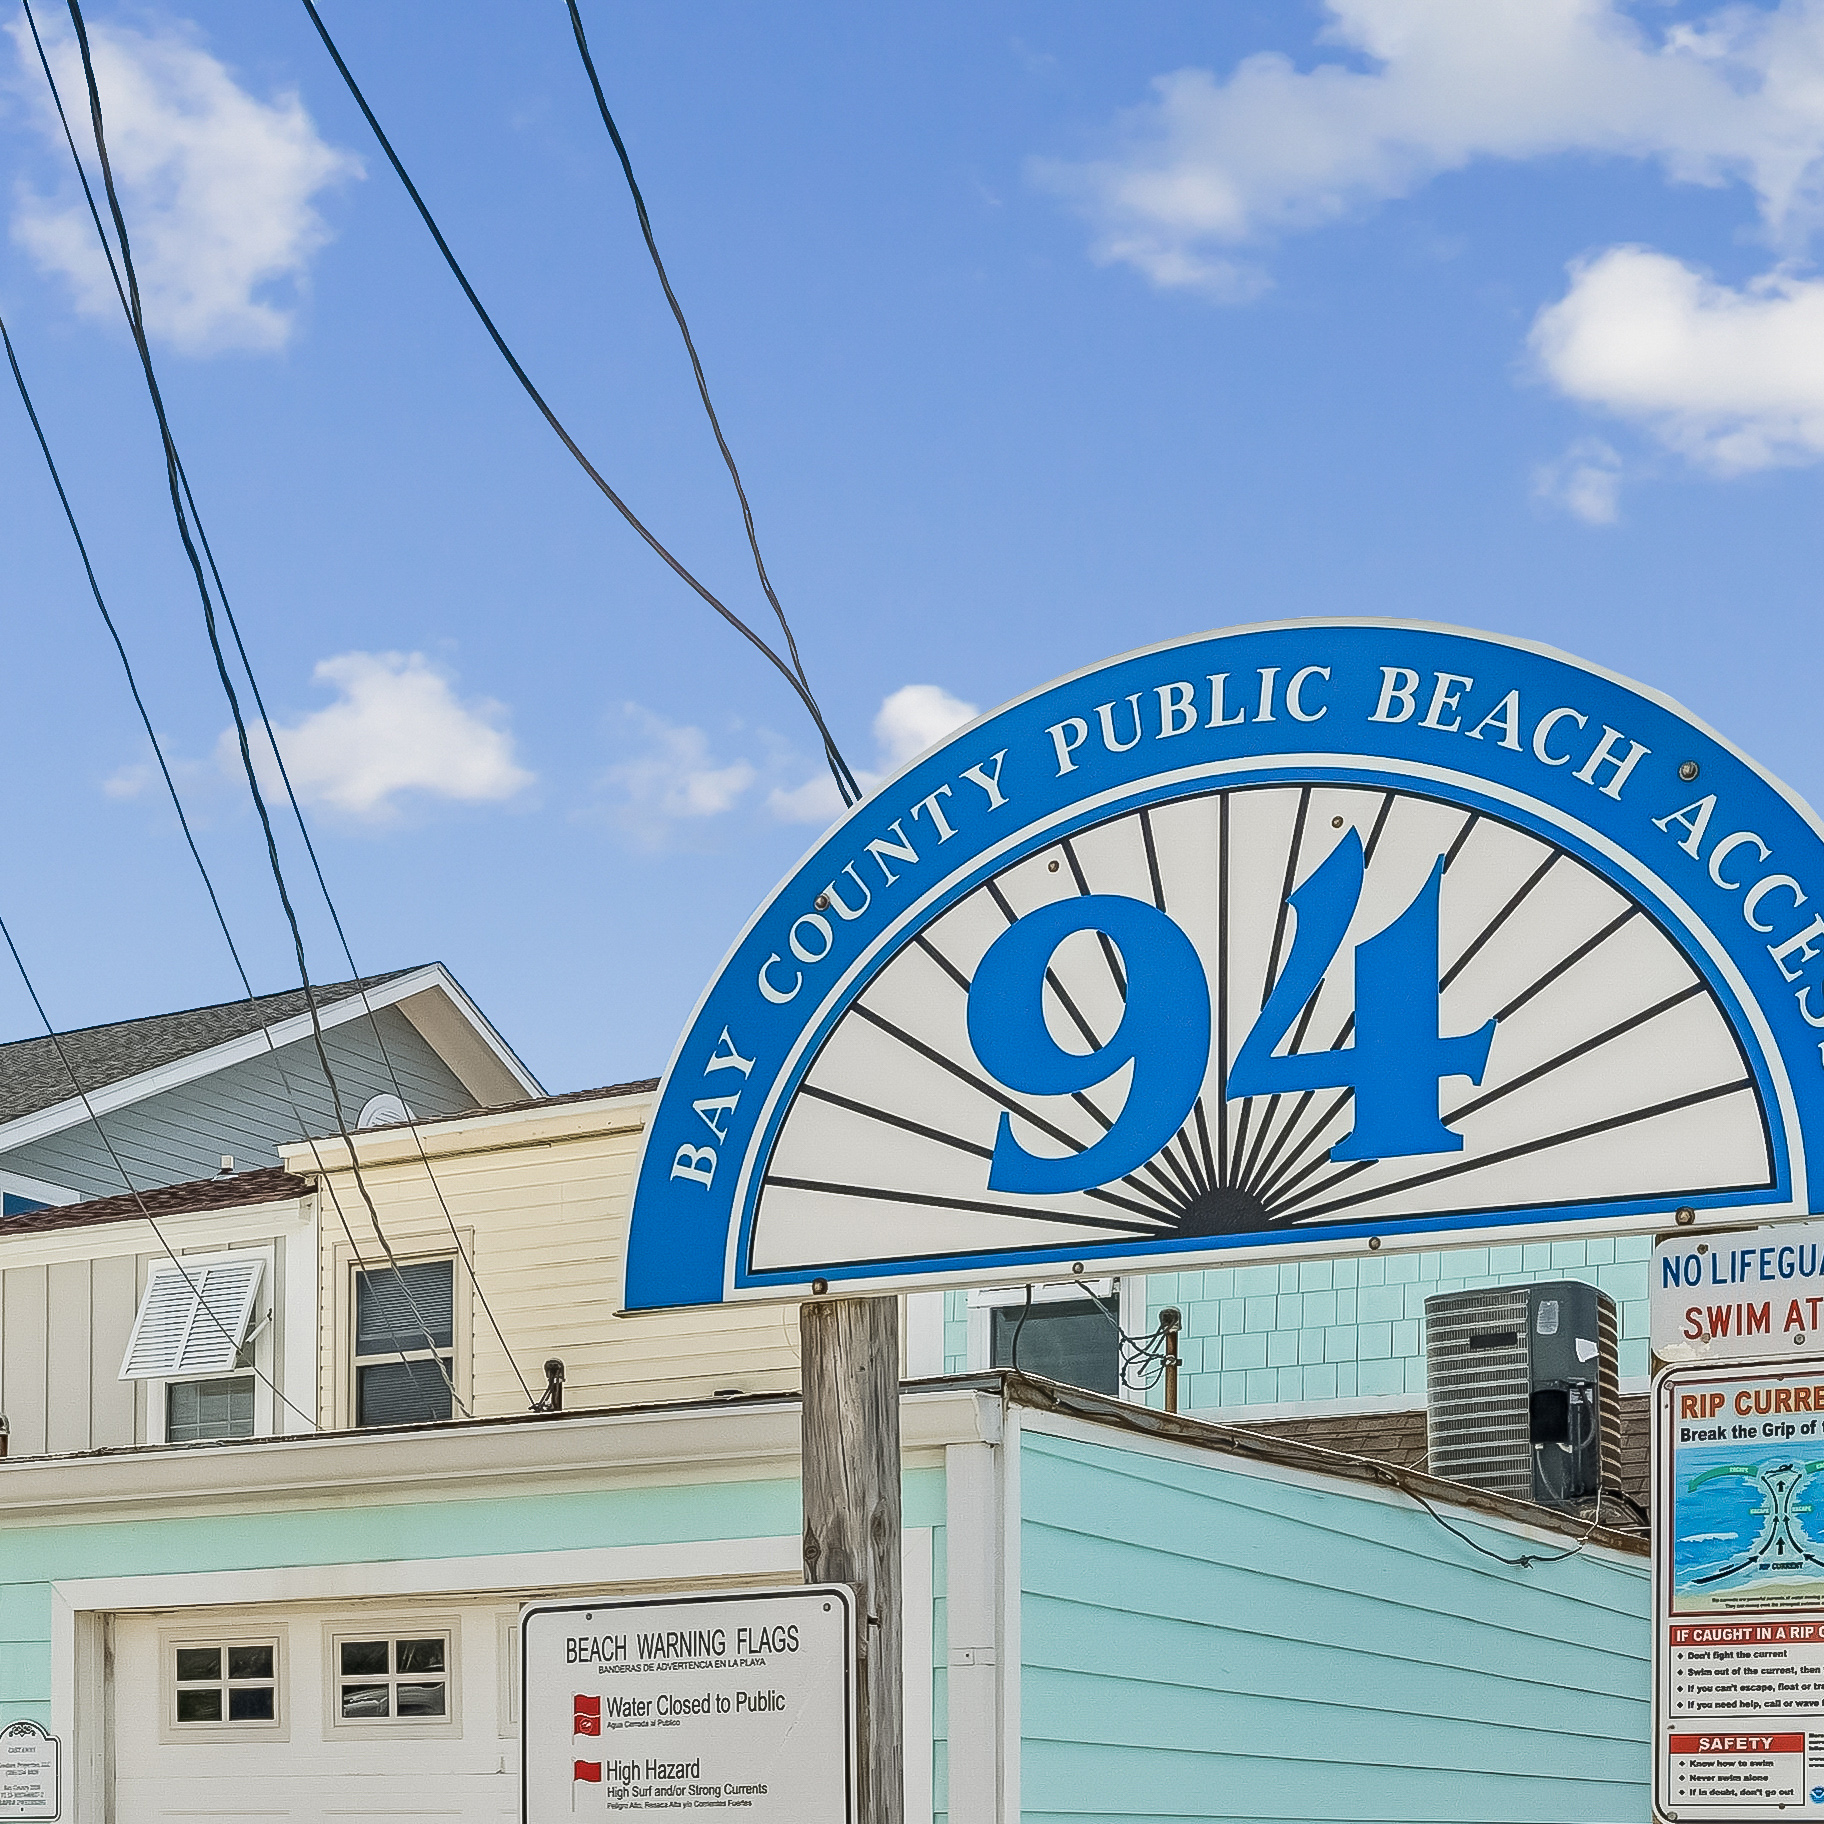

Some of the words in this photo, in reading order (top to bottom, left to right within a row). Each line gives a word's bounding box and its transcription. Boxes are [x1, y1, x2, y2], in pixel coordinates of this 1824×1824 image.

[670, 1027, 766, 1191] BAY
[757, 750, 1012, 1002] COUNTY
[1048, 662, 1331, 777] PUBLIC
[1368, 663, 1651, 802] BEACH
[968, 824, 1498, 1194] 94
[1663, 1253, 1703, 1288] NO
[1683, 1302, 1771, 1339] SWIM
[1784, 1298, 1824, 1332] AT
[1681, 1391, 1725, 1419] RIP
[1681, 1426, 1727, 1442] Break
[1732, 1425, 1757, 1438] the
[1763, 1422, 1795, 1439] Grip
[1801, 1420, 1817, 1434] of
[567, 1635, 626, 1663] BEACH
[637, 1629, 725, 1659] WARNING
[738, 1625, 799, 1654] FLAGS
[1676, 1630, 1689, 1642] IF
[1693, 1628, 1752, 1641] CAUGHT
[1756, 1628, 1771, 1639] IN
[1776, 1628, 1785, 1639] A
[1790, 1626, 1814, 1638] RIP
[599, 1664, 641, 1674] BANDERAS
[643, 1663, 654, 1672] DE
[656, 1661, 713, 1671] ADVERTENCIA
[715, 1660, 726, 1668] EN
[728, 1659, 738, 1667] LA
[740, 1658, 765, 1666] PLAYA
[1688, 1651, 1710, 1659] Don't
[1713, 1651, 1733, 1660] fight
[1753, 1650, 1787, 1658] current
[607, 1697, 652, 1717] Water
[657, 1693, 710, 1715] Closed
[715, 1694, 730, 1713] to
[737, 1690, 785, 1712] Public
[1699, 1737, 1773, 1750] SAFETY
[607, 1760, 640, 1786] High
[646, 1758, 699, 1779] Hazard
[608, 1787, 629, 1800] High
[632, 1786, 652, 1797] Surf
[655, 1785, 686, 1796] and/or
[688, 1785, 721, 1798] Strong
[724, 1784, 767, 1794] Currents
